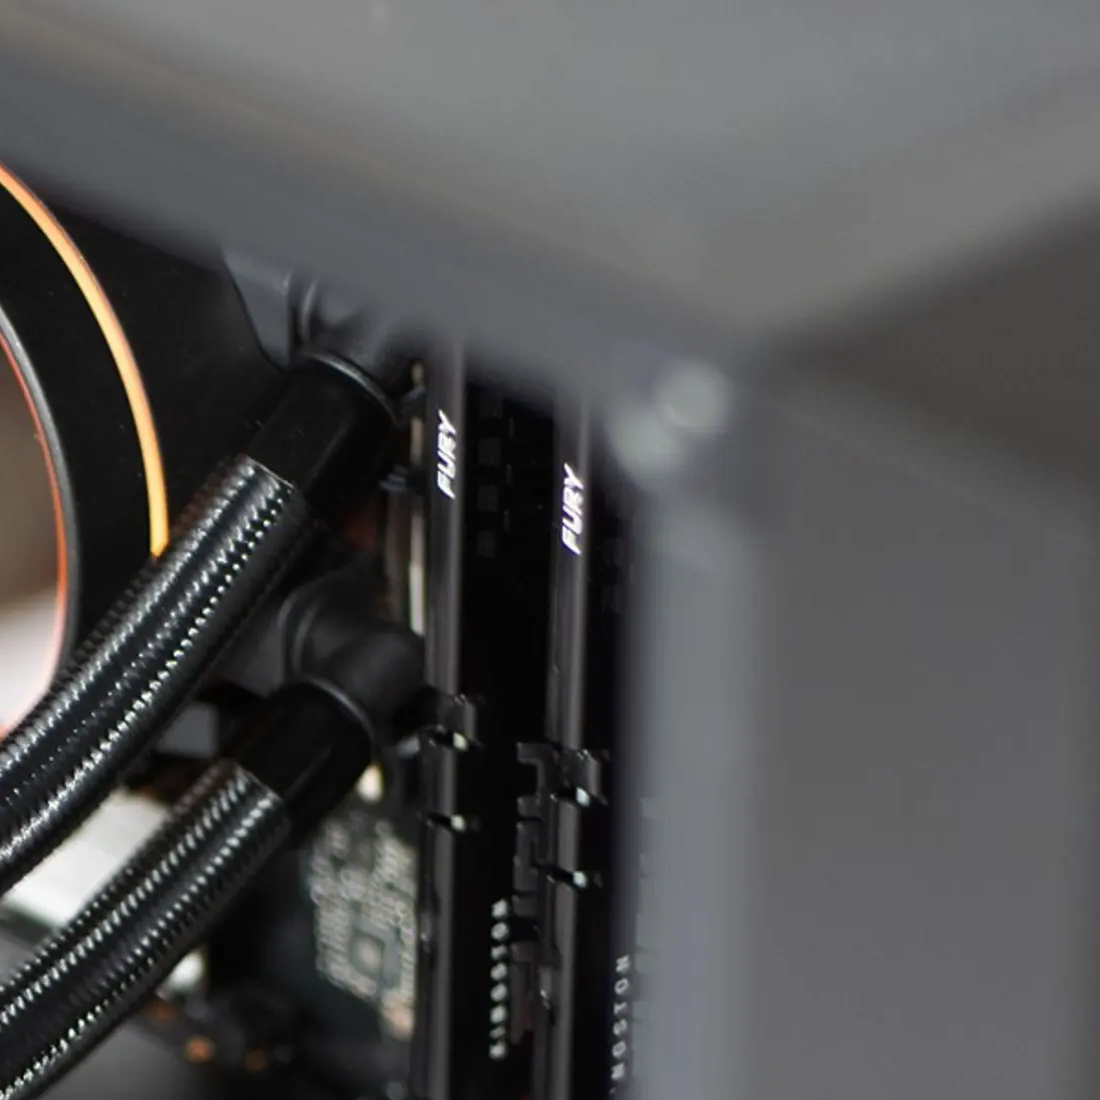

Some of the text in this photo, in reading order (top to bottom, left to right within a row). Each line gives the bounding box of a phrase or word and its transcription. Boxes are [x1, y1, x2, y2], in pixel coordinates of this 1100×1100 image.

[437, 409, 457, 500] FURY
[562, 462, 584, 556] FURY
[610, 955, 631, 1092] NGSTON
